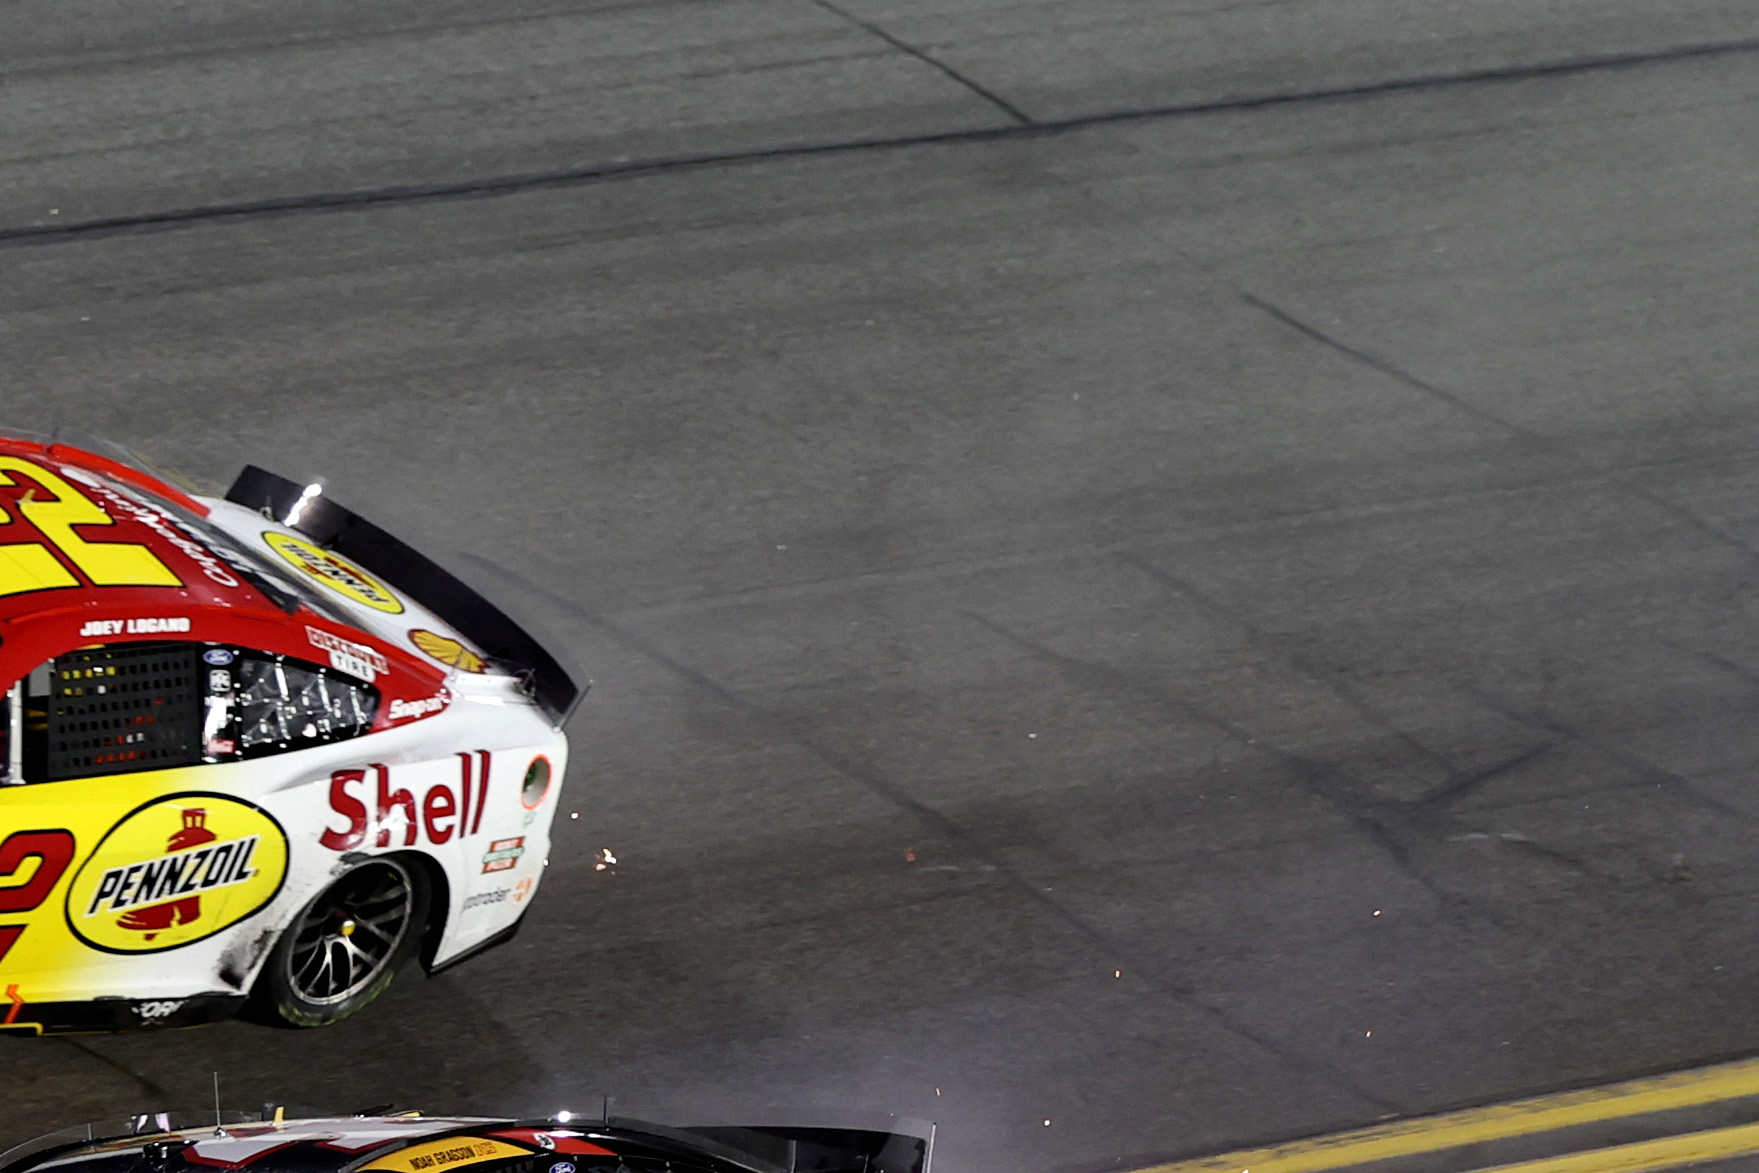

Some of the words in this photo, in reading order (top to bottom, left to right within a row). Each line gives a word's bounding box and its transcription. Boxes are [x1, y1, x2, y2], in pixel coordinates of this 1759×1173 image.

[80, 619, 124, 637] JOEY
[126, 617, 191, 634] LOGANO
[335, 654, 370, 678] TIRE
[319, 750, 491, 852] Shell
[86, 836, 259, 916] PENNZOIL
